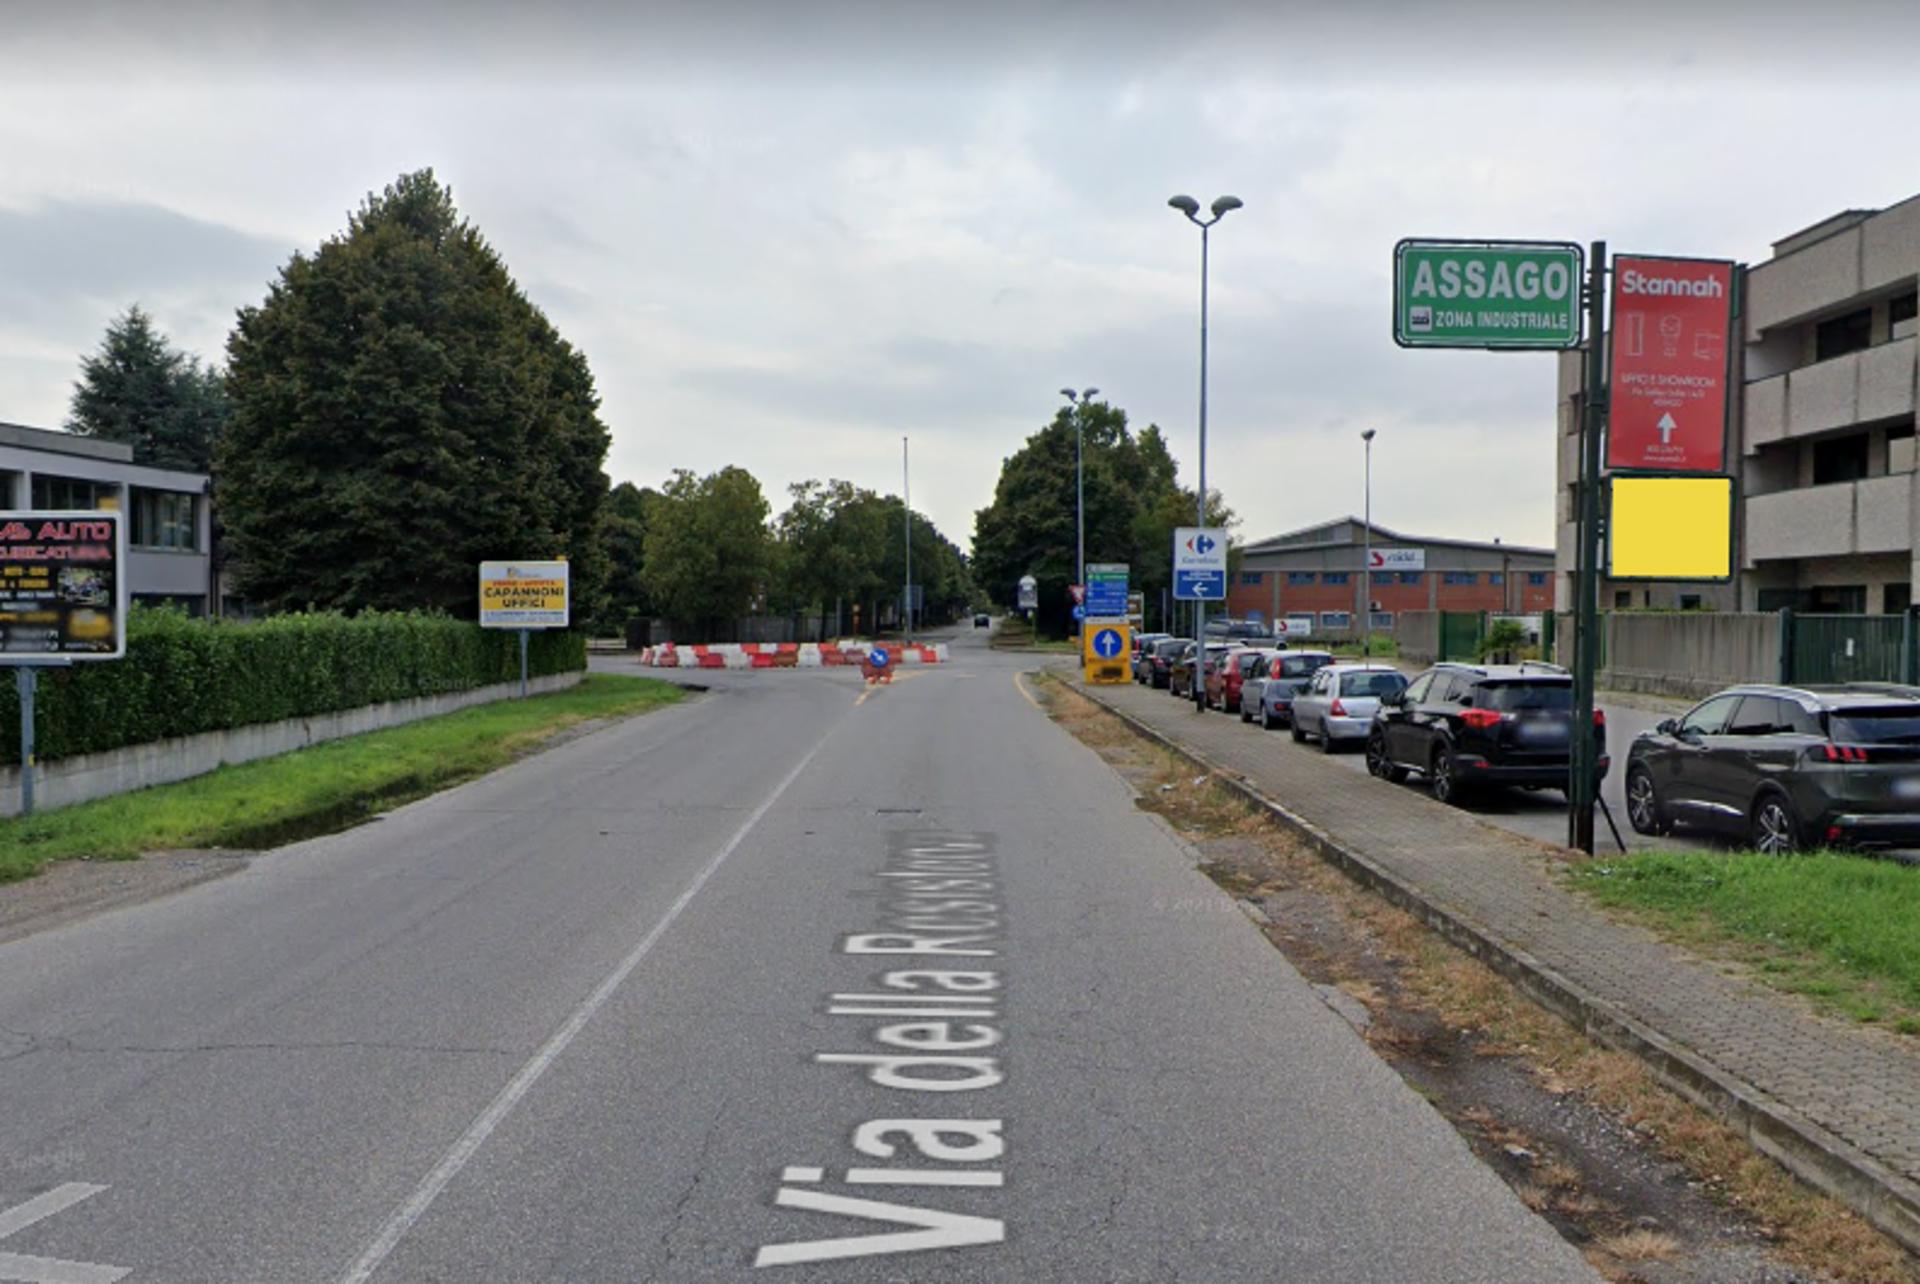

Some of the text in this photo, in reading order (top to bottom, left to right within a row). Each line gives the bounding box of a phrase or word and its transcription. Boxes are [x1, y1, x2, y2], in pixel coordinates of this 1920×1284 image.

[1412, 261, 1568, 299] ASSAGO
[1622, 270, 1721, 298] Stannah
[1436, 311, 1568, 330] ZONA INDUSTRIALE
[37, 522, 111, 540] AUTO
[484, 587, 564, 597] CAPANNONI
[502, 599, 545, 608] UFFICI
